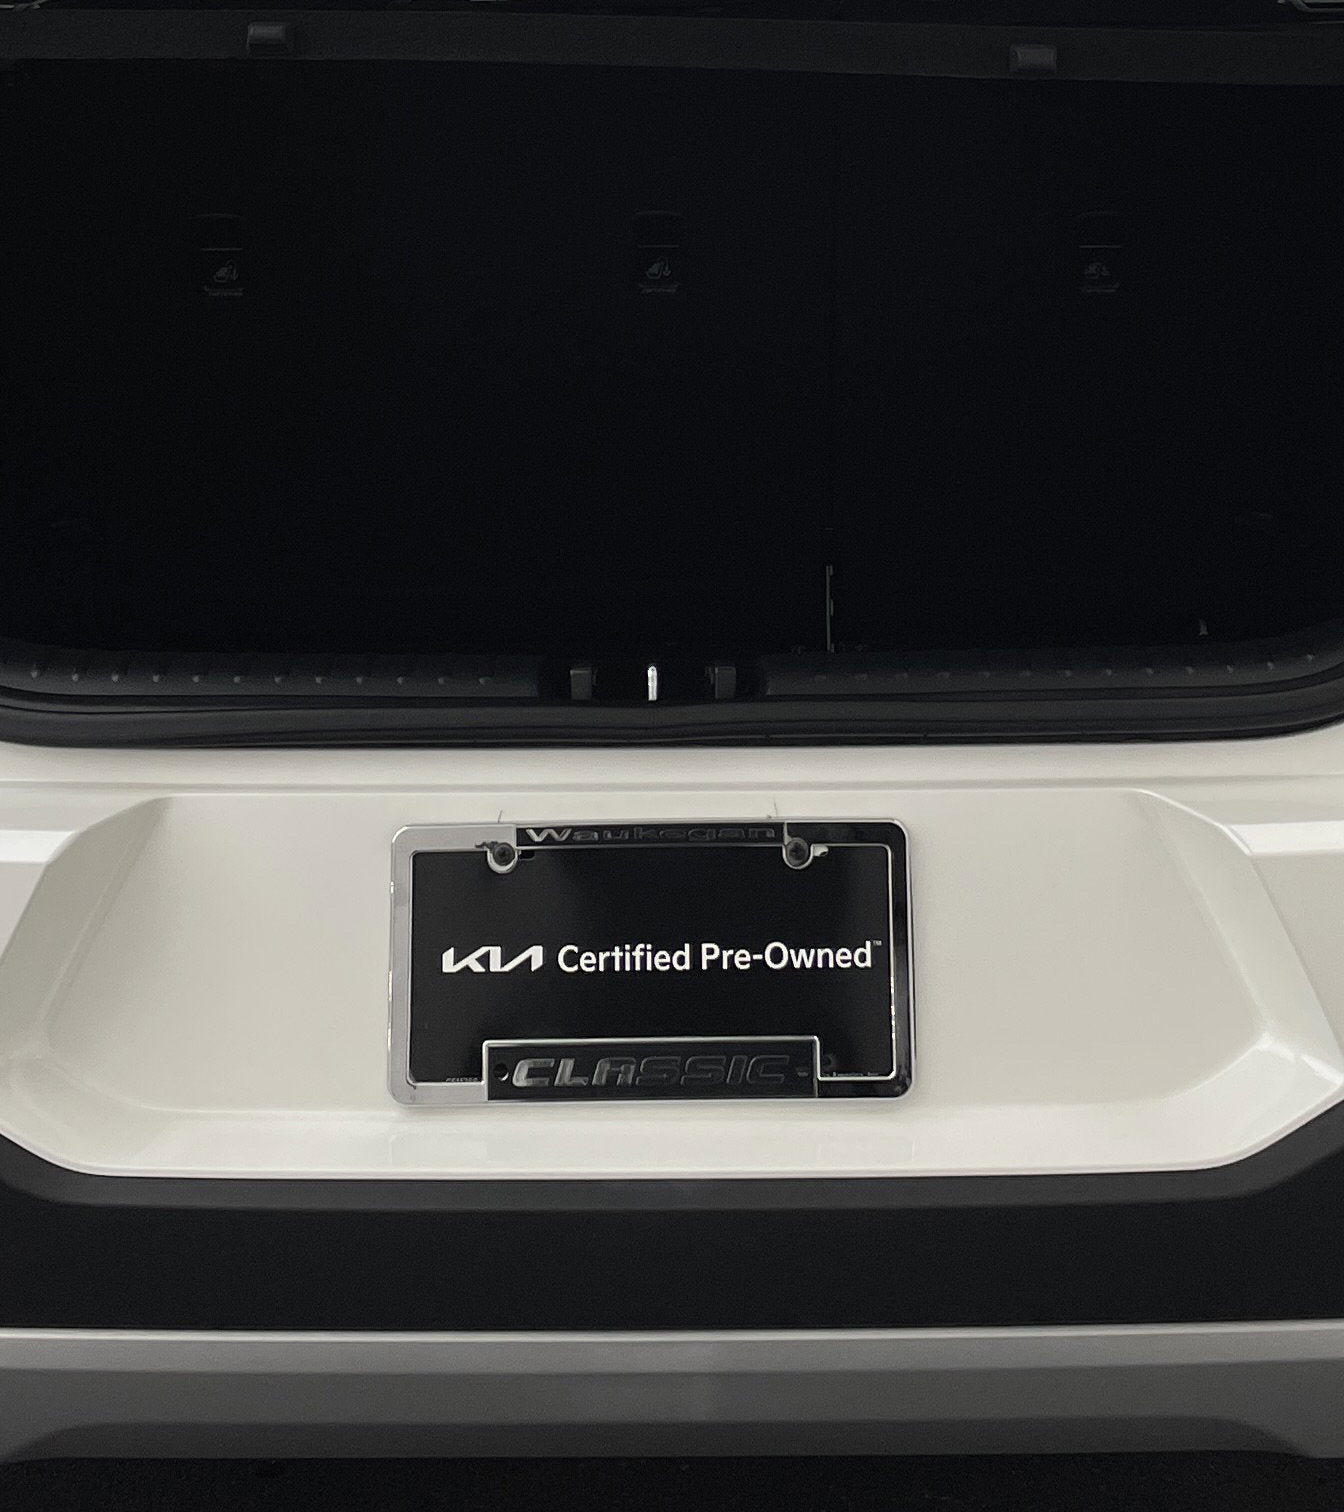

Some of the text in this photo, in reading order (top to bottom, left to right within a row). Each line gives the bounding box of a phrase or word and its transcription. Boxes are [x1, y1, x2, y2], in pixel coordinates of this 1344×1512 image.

[442, 944, 544, 973] KIA
[557, 942, 691, 973] Certified
[511, 1054, 790, 1089] CLASSIC
